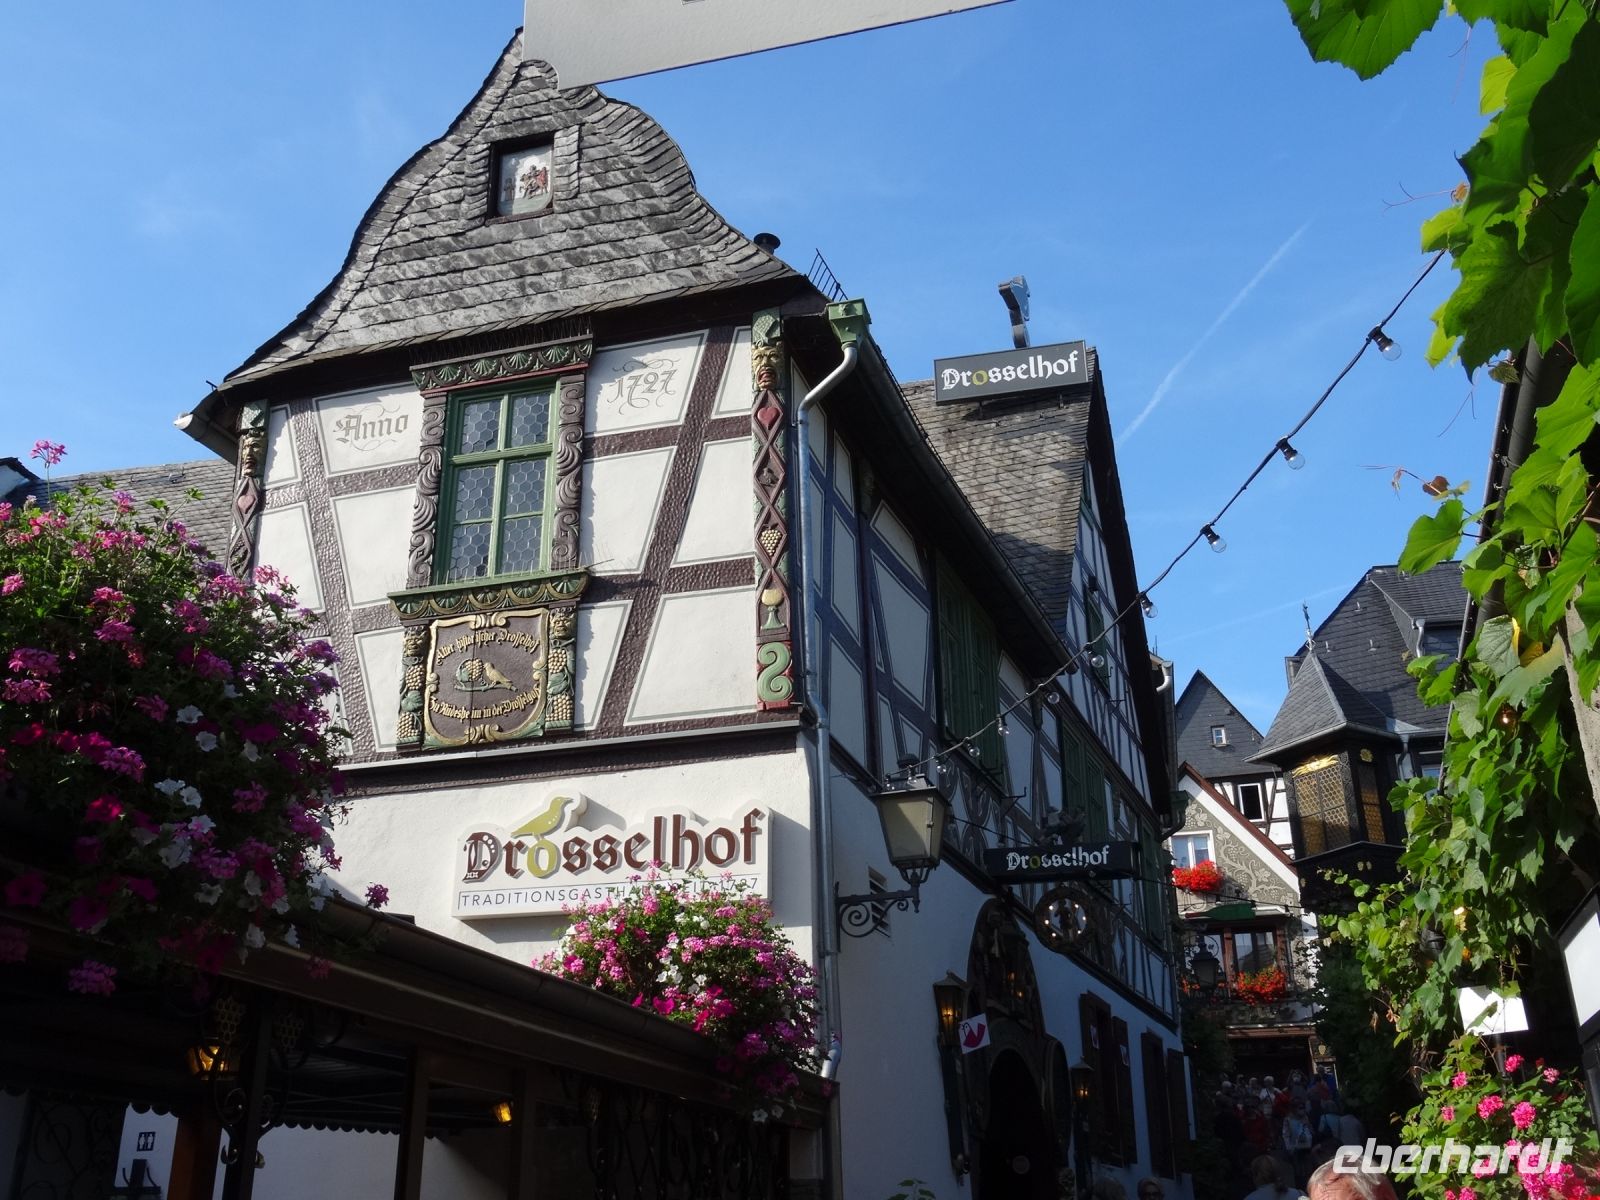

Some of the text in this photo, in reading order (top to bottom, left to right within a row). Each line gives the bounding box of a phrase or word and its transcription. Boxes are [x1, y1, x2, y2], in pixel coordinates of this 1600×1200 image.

[941, 350, 1078, 390] Drosselhof
[606, 369, 677, 409] 1727
[333, 414, 408, 443] Anno
[436, 643, 455, 665] Alter
[463, 807, 765, 883] Drosselhof
[1006, 845, 1110, 871] Drosselhof
